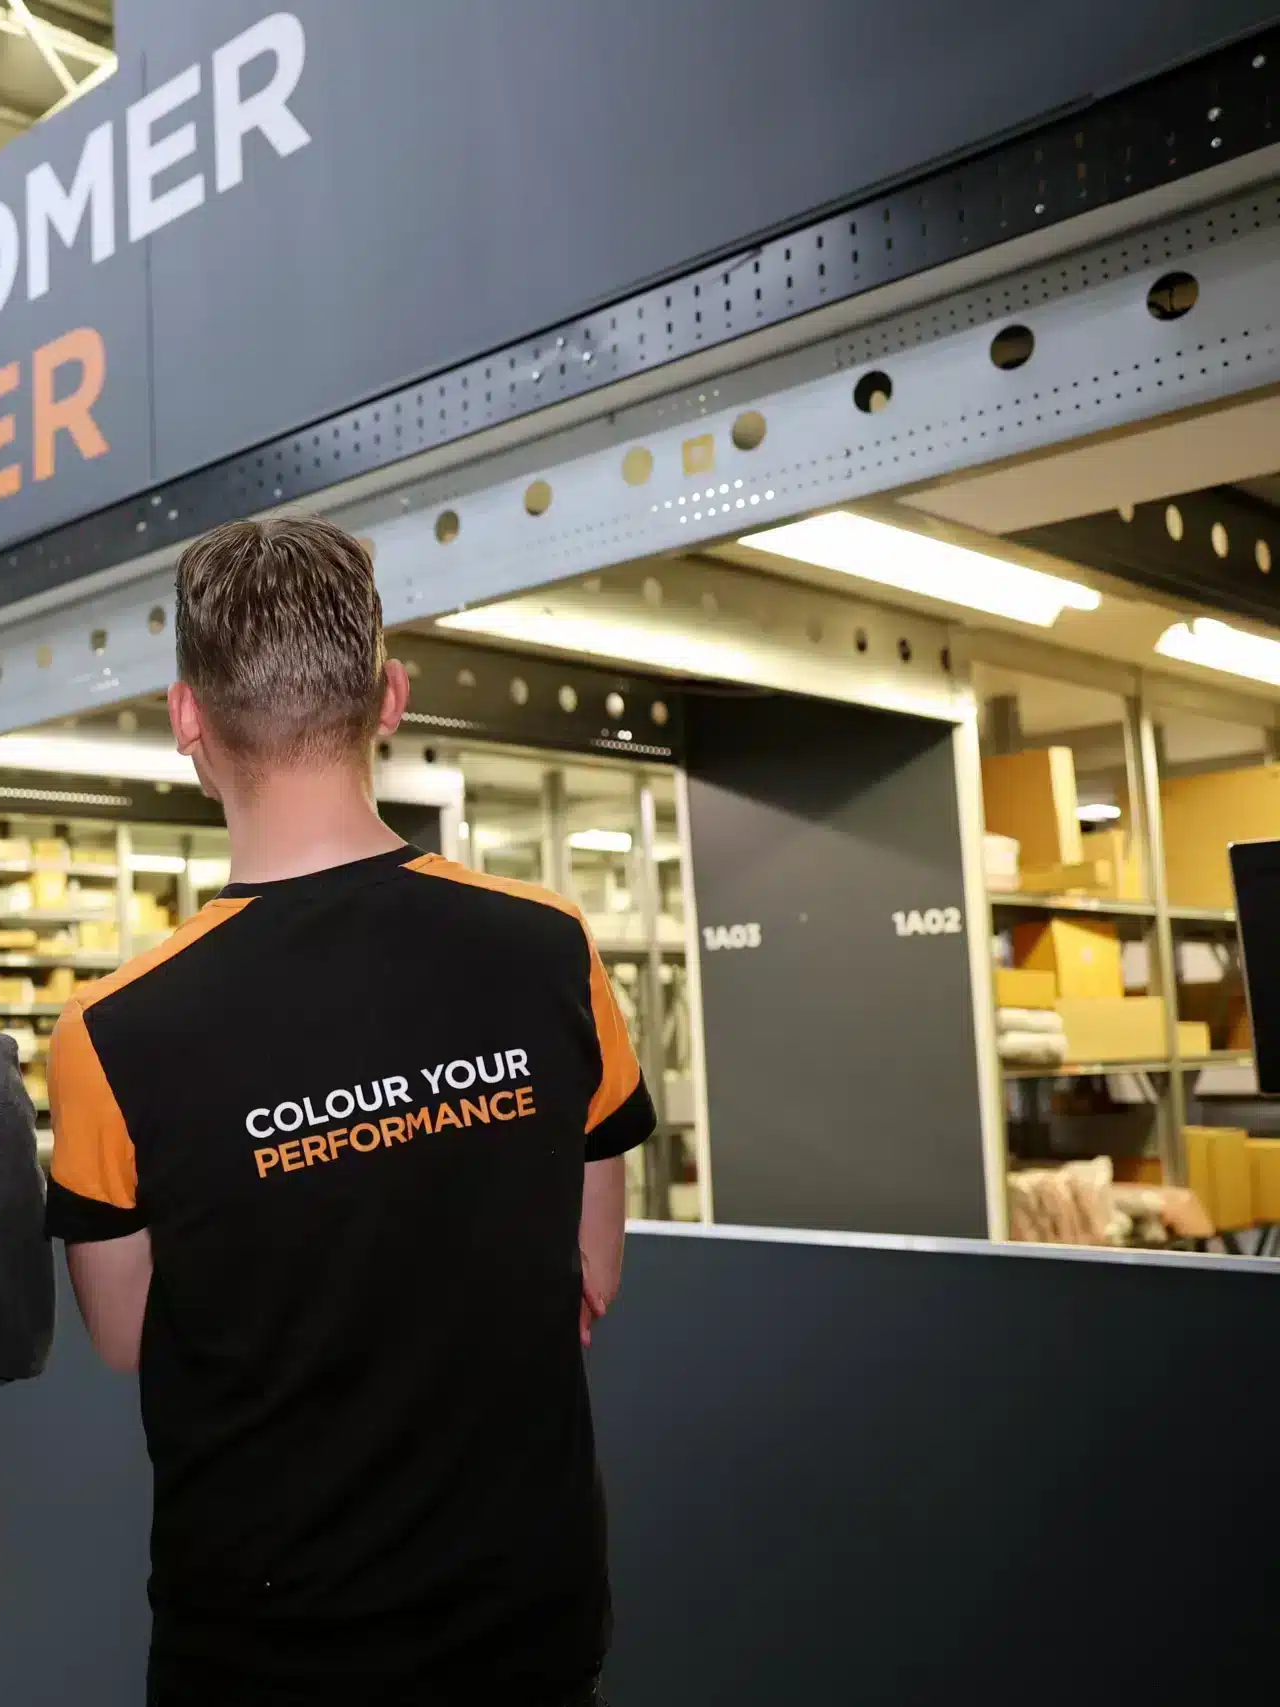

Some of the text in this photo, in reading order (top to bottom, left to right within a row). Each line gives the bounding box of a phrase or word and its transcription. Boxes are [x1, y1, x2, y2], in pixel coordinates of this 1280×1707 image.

[702, 922, 762, 951] 1A03
[891, 907, 962, 936] 1A02
[245, 1048, 531, 1138] COLOUR YOUR
[253, 1086, 537, 1178] PERFORMANCE
